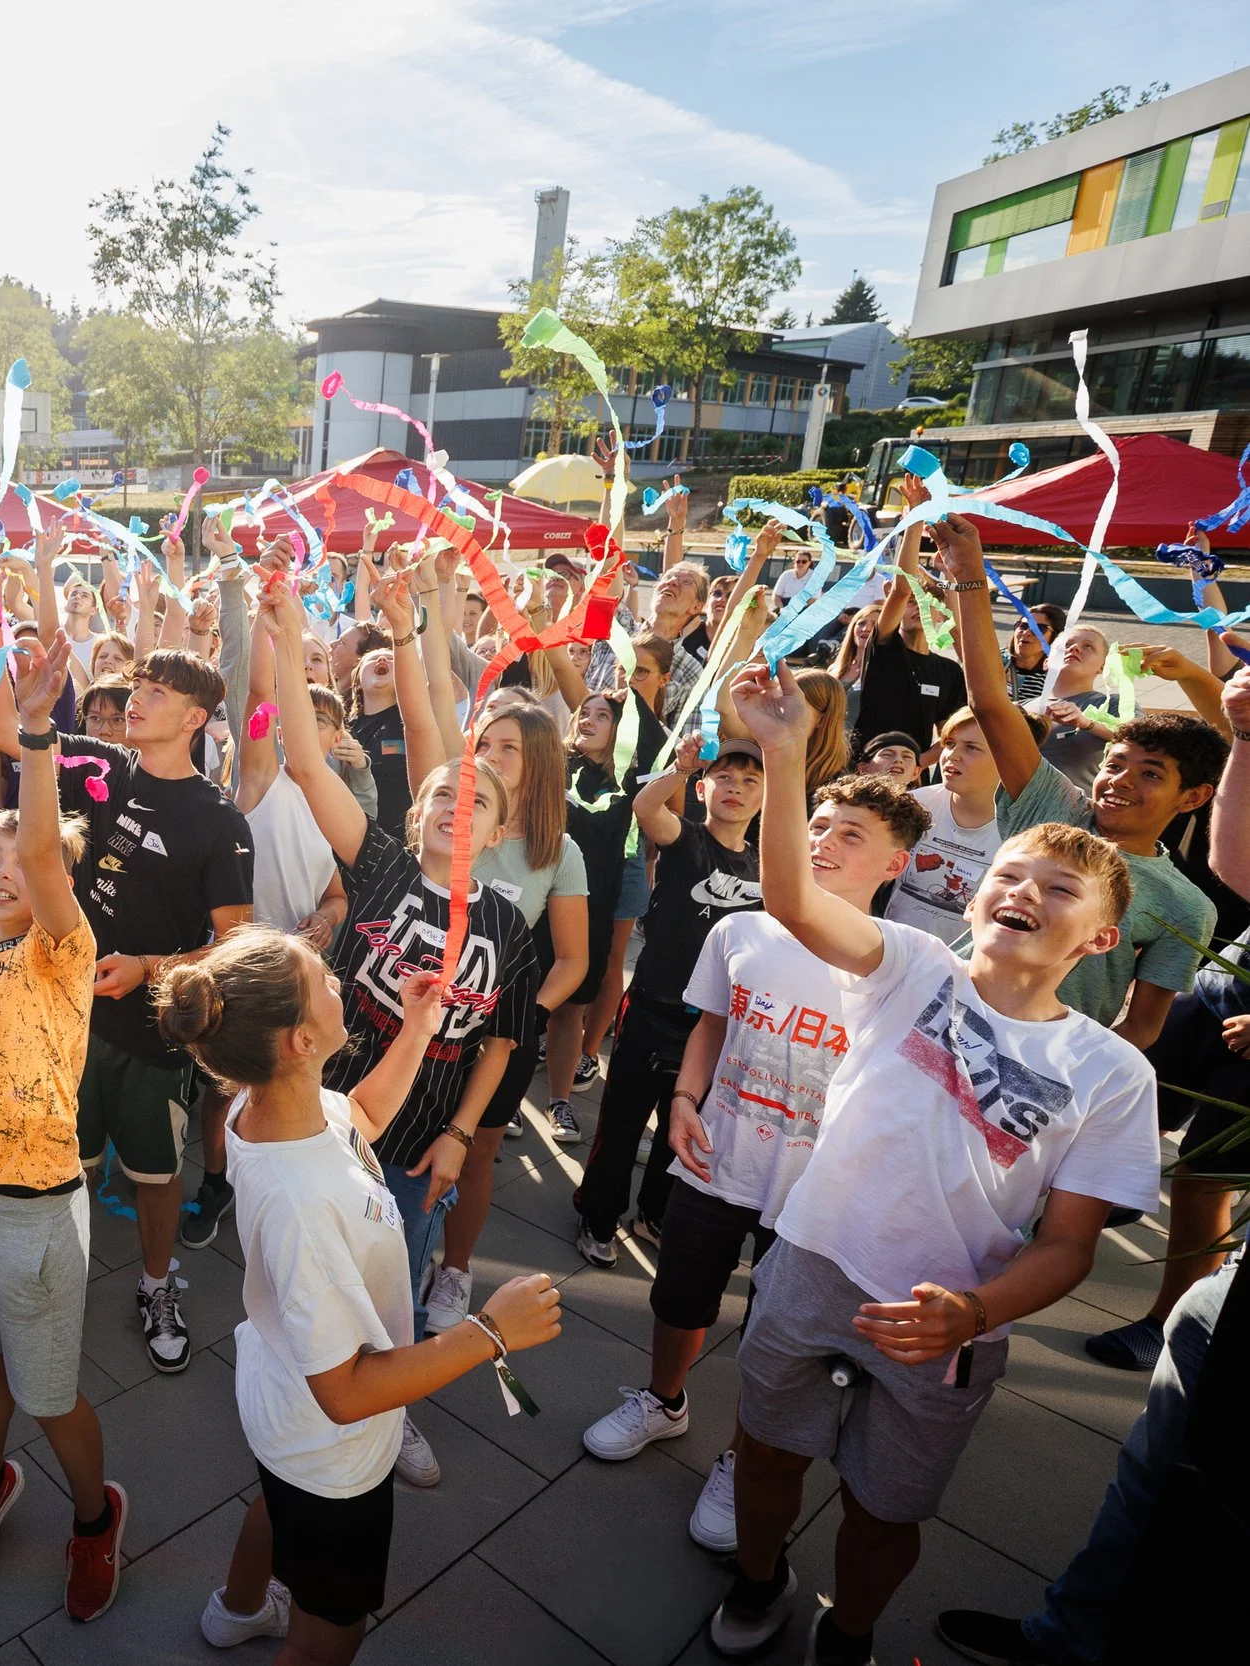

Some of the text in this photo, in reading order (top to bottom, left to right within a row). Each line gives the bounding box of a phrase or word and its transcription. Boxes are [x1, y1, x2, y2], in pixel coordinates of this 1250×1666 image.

[116, 813, 142, 838] NIKE
[96, 878, 117, 897] nike
[101, 902, 114, 917] Inc.
